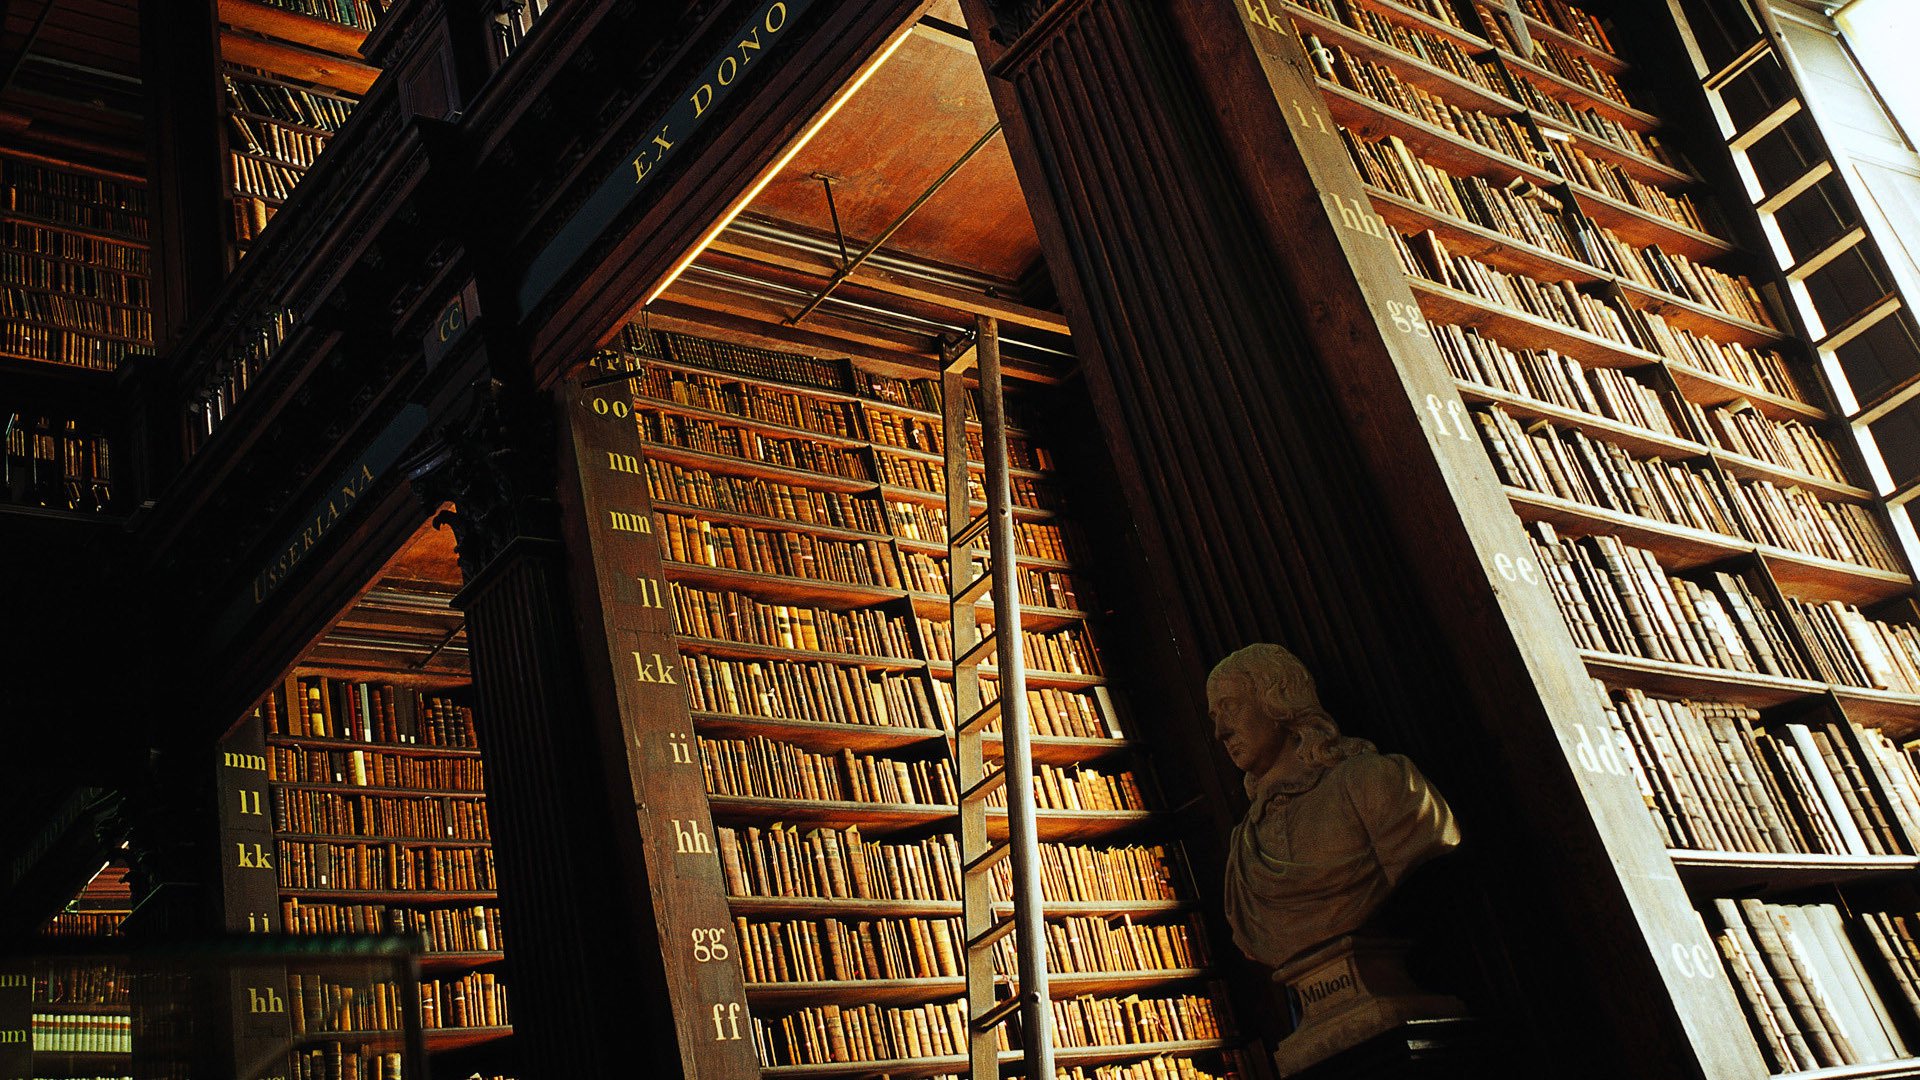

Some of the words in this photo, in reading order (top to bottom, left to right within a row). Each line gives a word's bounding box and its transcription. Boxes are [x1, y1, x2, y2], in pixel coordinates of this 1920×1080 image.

[1243, 0, 1288, 36] kk
[631, 124, 675, 184] EX
[689, 1, 787, 119] DONO
[1291, 99, 1330, 136] ii
[1330, 192, 1385, 239] hh
[1386, 299, 1431, 338] gg
[592, 397, 628, 418] oo
[1426, 394, 1472, 441] ff
[607, 451, 640, 474] nn
[252, 463, 374, 605] USSERIANA
[609, 511, 651, 533] mm
[1494, 552, 1539, 586] ee
[637, 577, 664, 609] ll
[631, 651, 677, 685] kk
[223, 752, 266, 771] mm
[669, 732, 692, 764] ii
[1571, 723, 1627, 777] dd
[239, 789, 263, 816] ll
[671, 819, 712, 854] hh
[236, 842, 273, 869] kk
[248, 912, 270, 933] ii
[691, 927, 728, 963] gg
[1671, 942, 1716, 980] cc
[247, 988, 284, 1014] hh
[1301, 973, 1351, 1008] Milton
[712, 1003, 742, 1041] ff
